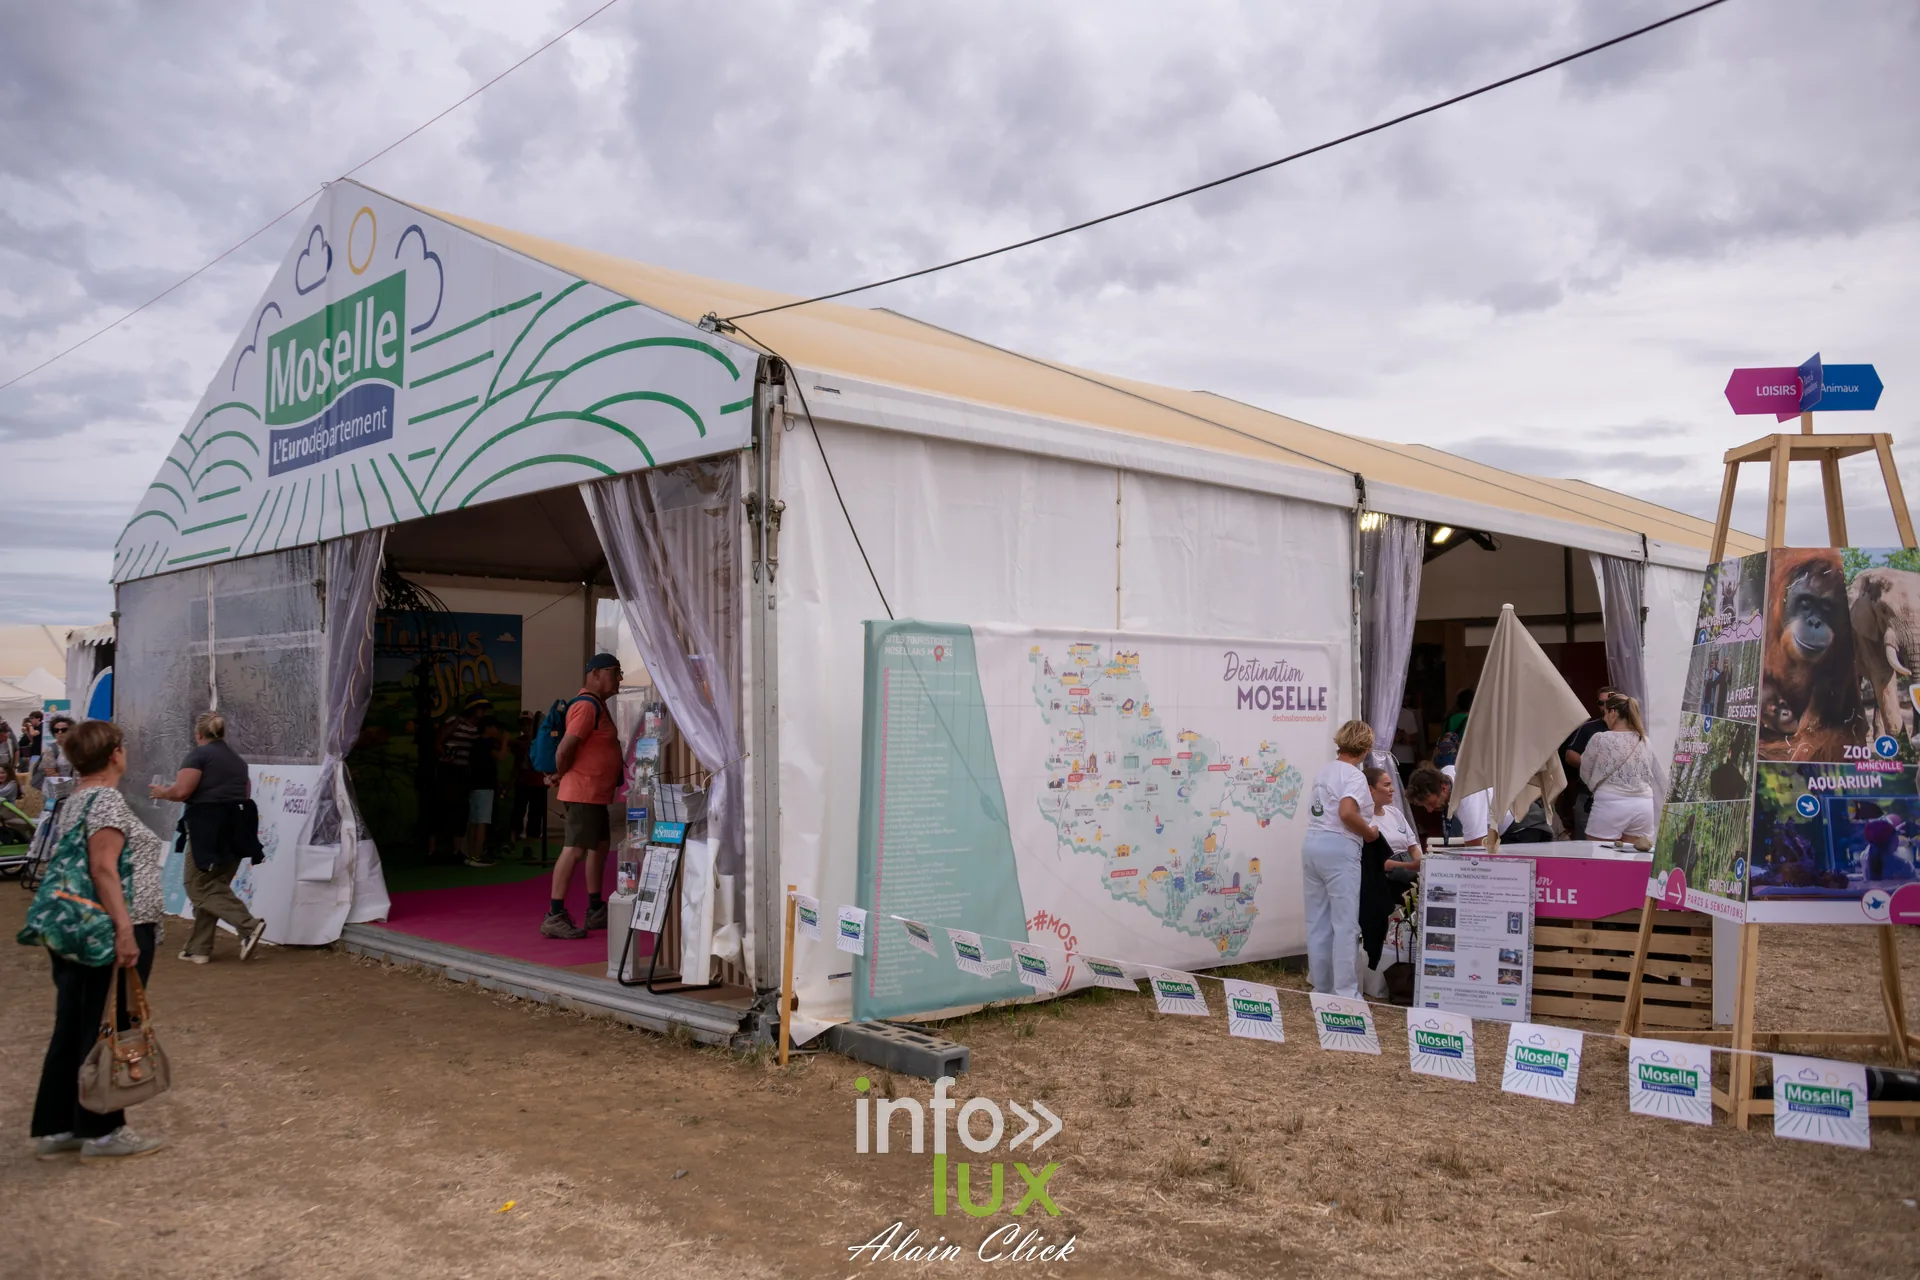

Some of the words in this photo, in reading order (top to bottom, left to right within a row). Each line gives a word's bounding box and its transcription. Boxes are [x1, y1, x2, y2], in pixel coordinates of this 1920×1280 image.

[270, 296, 397, 413] Moselle
[1756, 384, 1796, 396] LOISIRS
[1821, 383, 1859, 393] Animaux
[273, 405, 388, 465] L'Eurodépartement
[885, 634, 904, 644] SITES
[1223, 651, 1304, 682] Destination
[1237, 685, 1327, 711] MOSELLE
[1726, 689, 1735, 703] LA
[1735, 684, 1755, 701] FORÊT
[1727, 705, 1739, 718] DES
[1739, 702, 1757, 718] DÉFIS
[1843, 745, 1872, 759] ZOO
[1808, 775, 1882, 792] AQUARIUM
[1536, 887, 1577, 904] ELLE
[1687, 894, 1703, 907] PARCS
[1710, 900, 1743, 919] SENSATIONS
[841, 920, 860, 933] Moselle
[956, 942, 980, 957] Moselle
[1019, 955, 1046, 970] Moselle
[1091, 963, 1121, 974] Moselle
[1157, 981, 1193, 993] Moselle
[1234, 999, 1271, 1014] Moselle
[1322, 1013, 1365, 1028] Moselle
[1417, 1032, 1462, 1050] Moselle
[1516, 1047, 1566, 1067] Moselle
[1641, 1066, 1696, 1086] Moselle
[1787, 1086, 1850, 1104] Moselle
